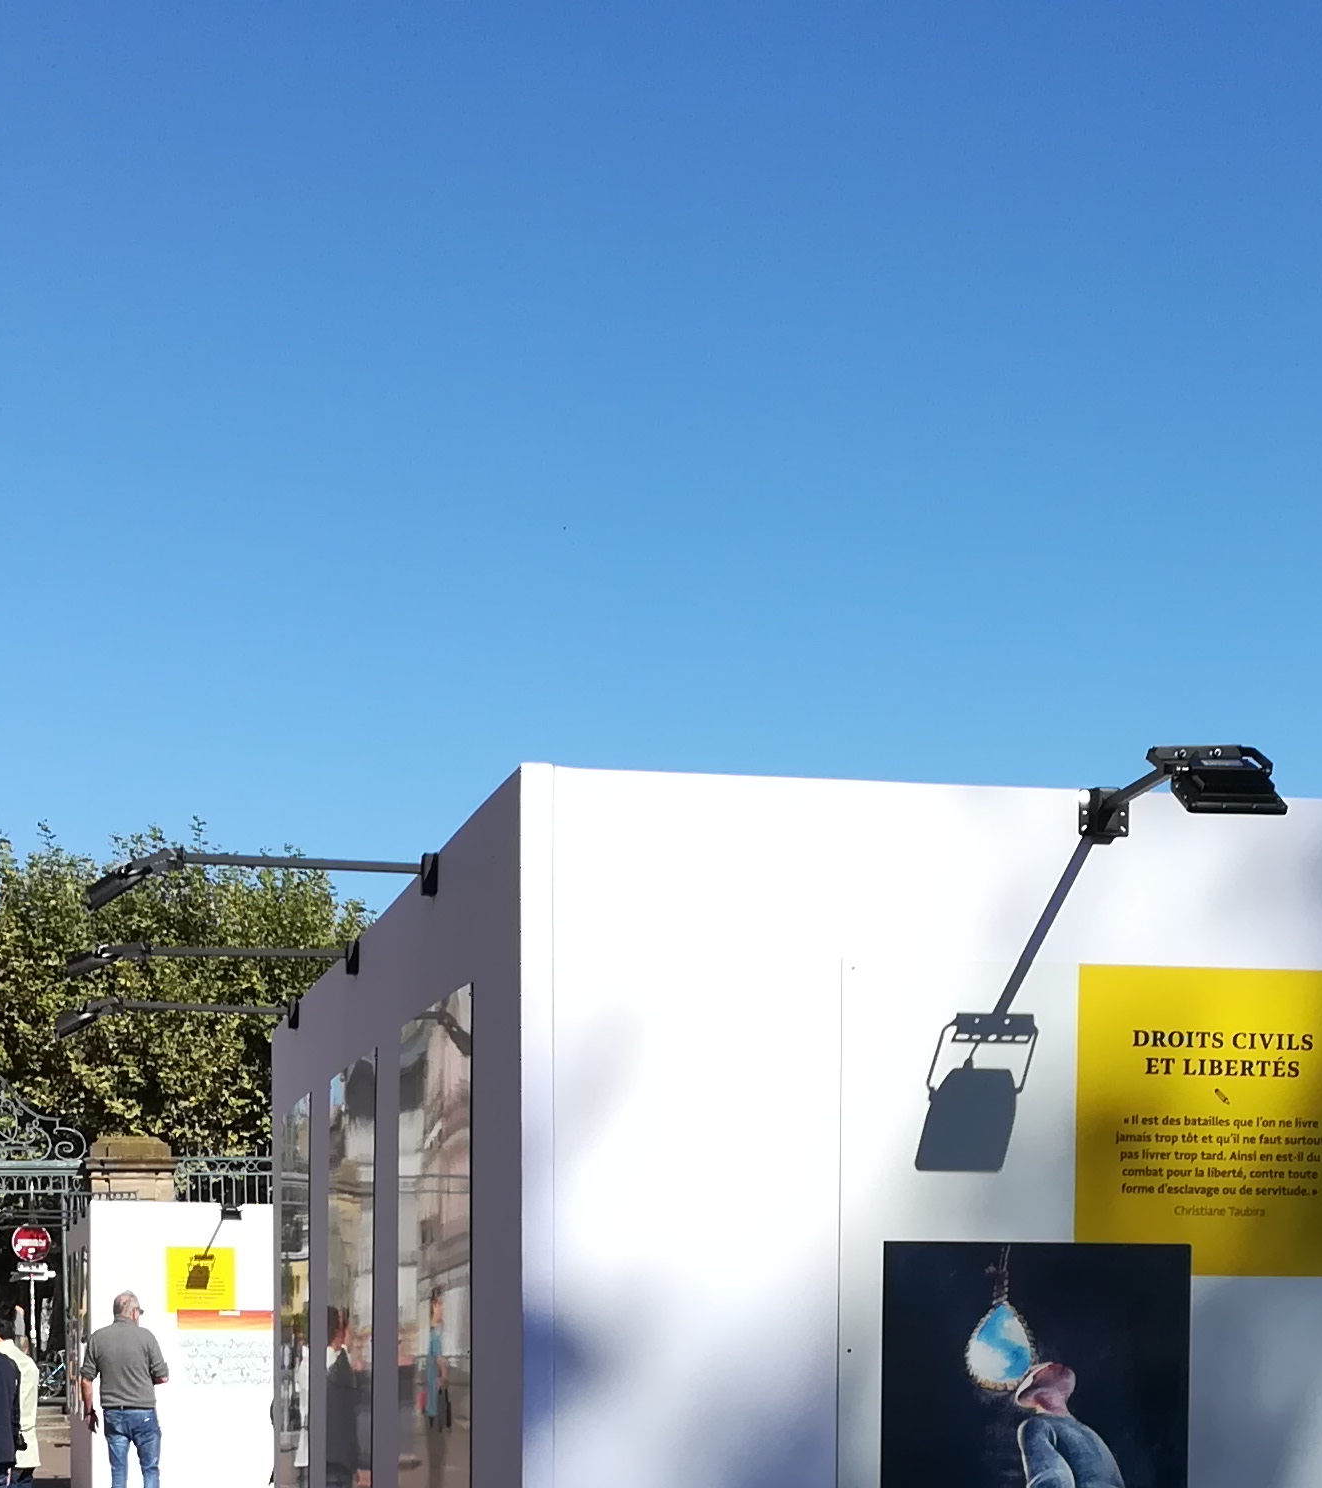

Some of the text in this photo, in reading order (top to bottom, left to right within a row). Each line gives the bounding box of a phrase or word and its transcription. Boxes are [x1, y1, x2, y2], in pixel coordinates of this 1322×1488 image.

[1132, 1030, 1314, 1051] DROITS CIVILS
[1145, 1057, 1300, 1078] ET LIBERTÉS
[1141, 1116, 1159, 1126] est
[1161, 1115, 1181, 1126] des
[1184, 1116, 1230, 1127] batailles
[1233, 1119, 1254, 1130] que
[1256, 1117, 1276, 1128] l'on
[1278, 1120, 1293, 1128] ne
[1294, 1118, 1319, 1129] livre
[1115, 1131, 1152, 1145] jamais
[1155, 1133, 1178, 1146] trop
[1181, 1132, 1198, 1144] tôt
[1201, 1134, 1213, 1144] et
[1216, 1133, 1240, 1147] qu'il
[1242, 1136, 1256, 1145] ne
[1259, 1134, 1282, 1145] faut
[1120, 1148, 1321, 1163] pas livrer trop tard. Ainsi en est-il du
[1121, 1166, 1319, 1181] combat pour la liberté, contre toute
[1121, 1182, 1155, 1194] forme
[1157, 1183, 1220, 1198] d'esclavage
[1222, 1186, 1237, 1195] ou
[1238, 1184, 1253, 1196] de
[1173, 1205, 1266, 1217] Christiane Taubira
